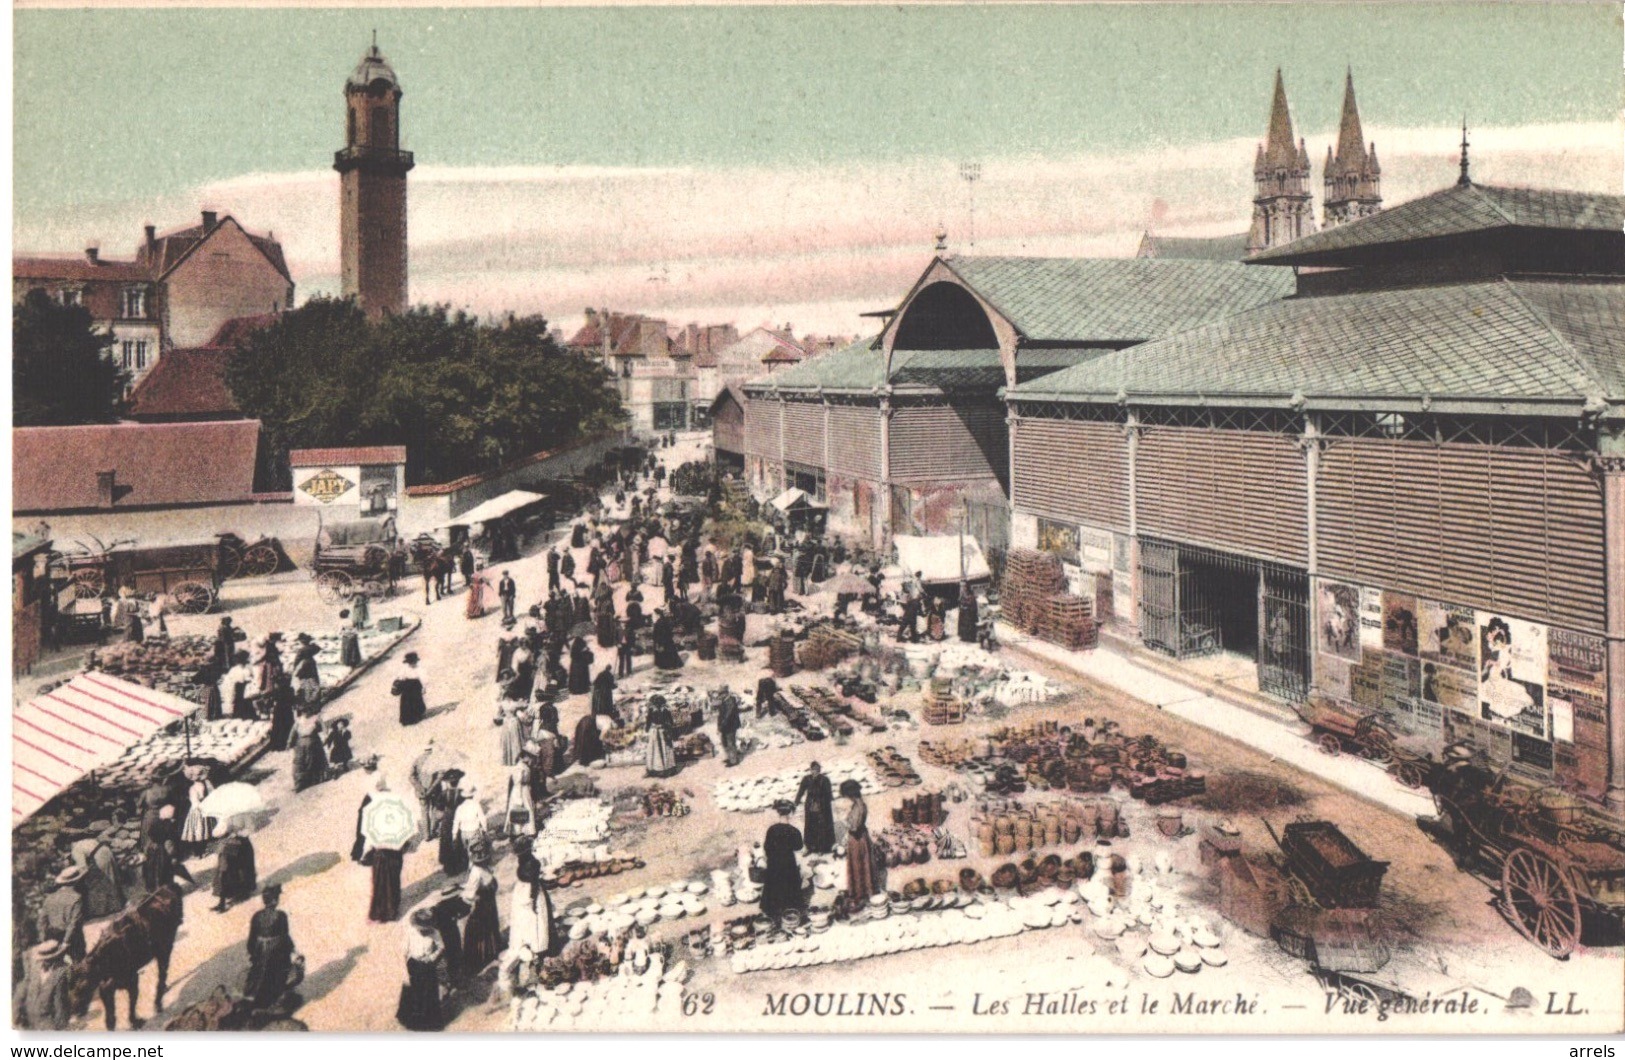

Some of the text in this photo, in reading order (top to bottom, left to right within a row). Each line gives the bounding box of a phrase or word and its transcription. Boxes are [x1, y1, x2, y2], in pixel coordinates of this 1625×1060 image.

[306, 479, 345, 495] JAPY
[1439, 603, 1475, 617] SUPPLICE
[1552, 630, 1604, 652] ASSURANCES
